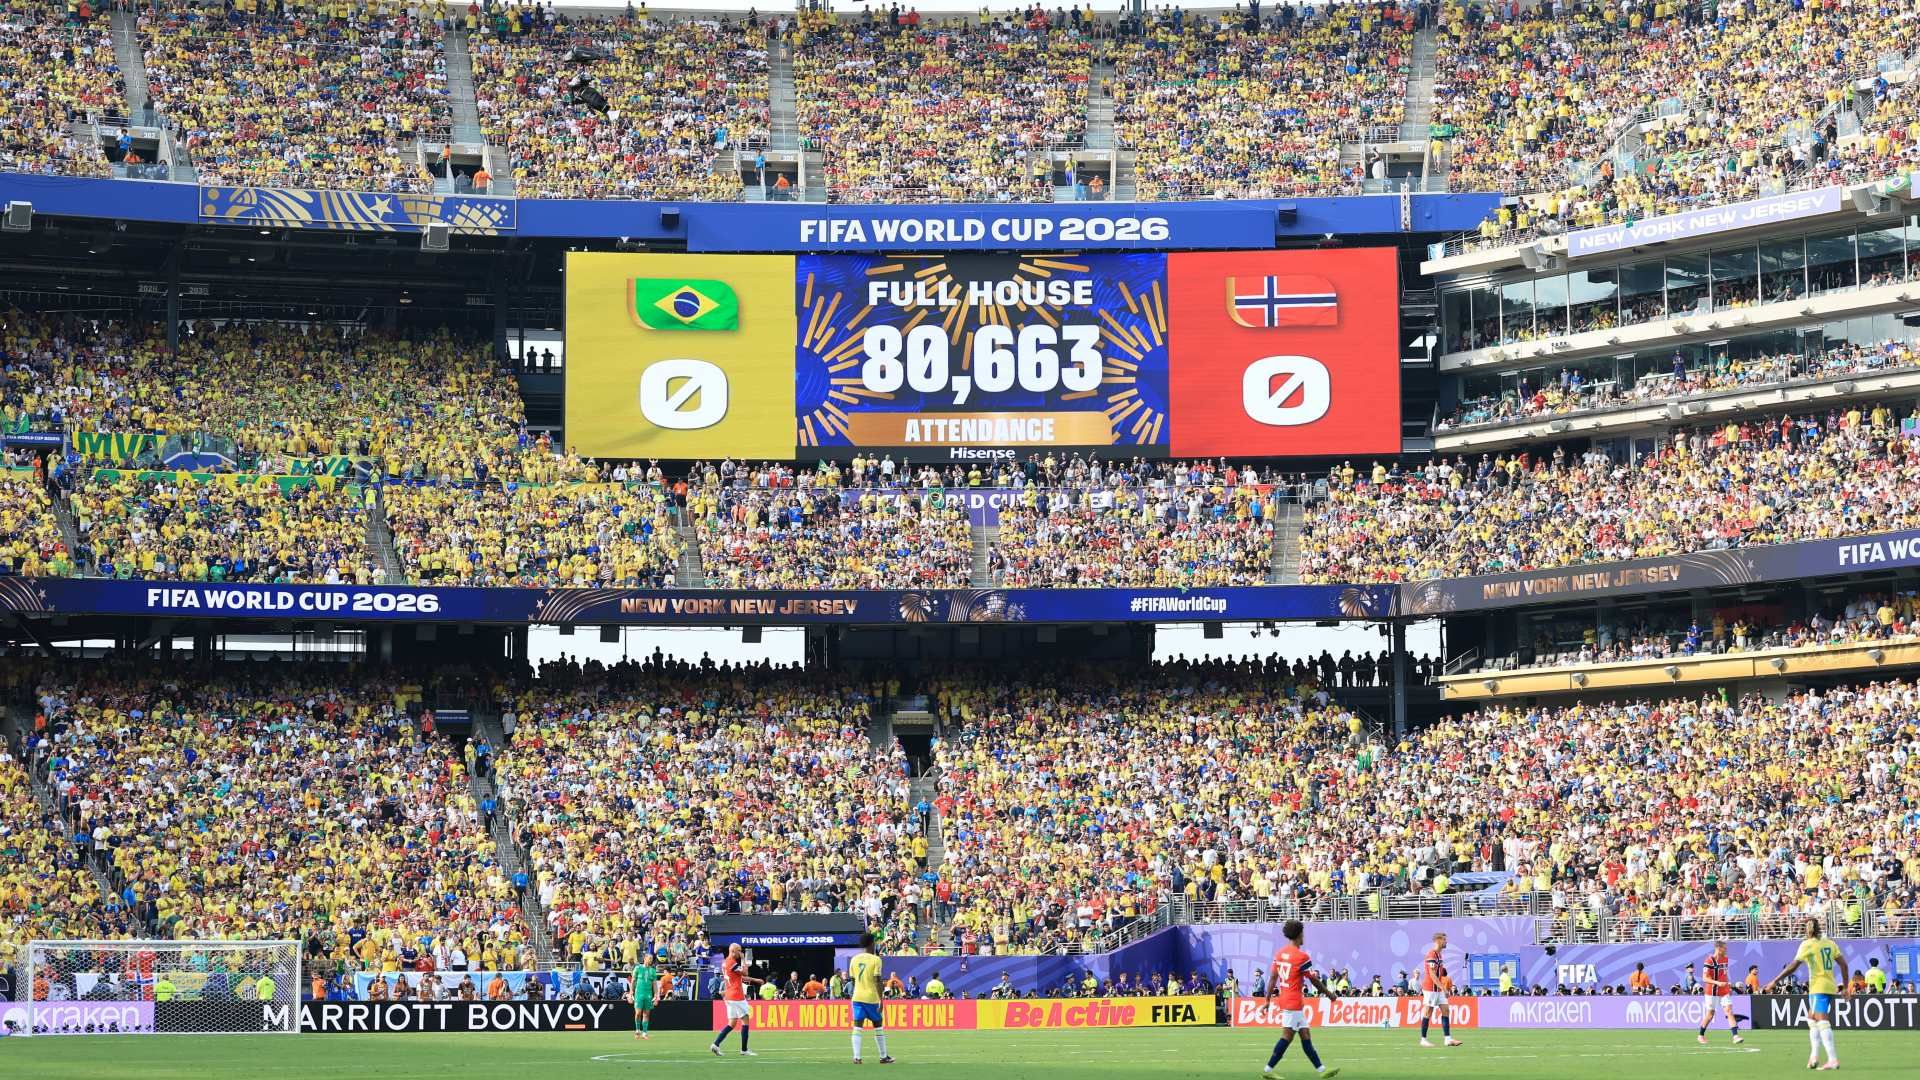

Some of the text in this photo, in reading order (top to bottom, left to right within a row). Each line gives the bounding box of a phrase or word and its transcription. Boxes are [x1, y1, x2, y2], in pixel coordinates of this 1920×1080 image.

[800, 217, 1169, 242] FIFA WORLD CUP 2026
[1579, 195, 1826, 249] NEW YORK NEW JERSEY
[868, 280, 1093, 306] FULL HOUSE
[862, 324, 1103, 405] 80,663
[640, 358, 729, 430] 0
[1242, 354, 1331, 427] 0
[905, 418, 1054, 442] ATTENDANCE
[950, 447, 1016, 459] Hisense
[1838, 542, 1886, 566] FIFA
[1483, 565, 1681, 600] NEW YORK NEW JERSEY
[147, 588, 439, 612] FIFA WORLD CUP 2026
[620, 598, 858, 615] NEW YORK NEW JERSEY
[1130, 597, 1227, 613] #FIFAWorldCup
[1820, 947, 1833, 971] 18
[1558, 964, 1598, 984] FIFA
[34, 1006, 140, 1028] kraken
[263, 1003, 452, 1030] MARRIOTT
[912, 1004, 955, 1028] FUN!
[1004, 1000, 1136, 1028] Be Active
[1151, 1004, 1197, 1024] FIFA
[1328, 999, 1391, 1025] Betano
[1527, 1001, 1592, 1023] kraken
[1771, 998, 1918, 1027] MARIOTT
